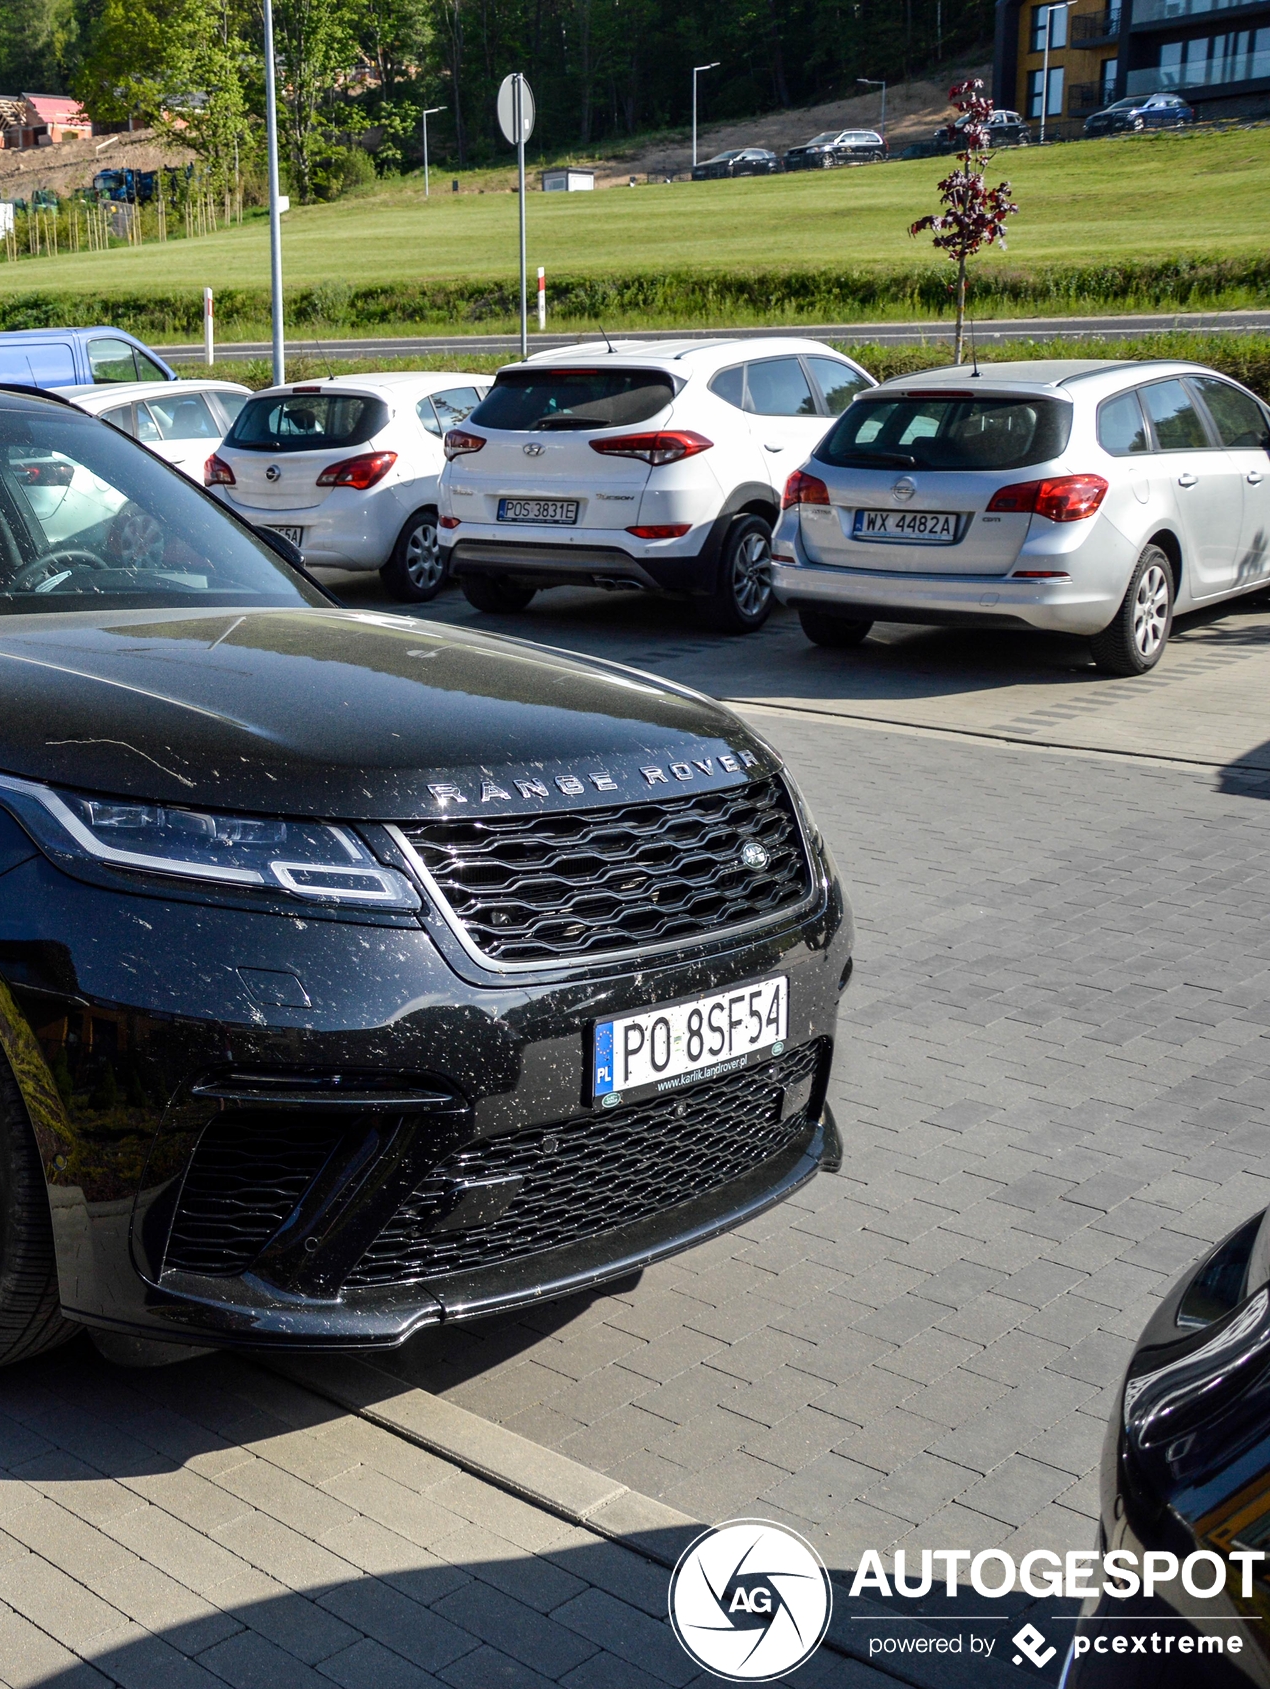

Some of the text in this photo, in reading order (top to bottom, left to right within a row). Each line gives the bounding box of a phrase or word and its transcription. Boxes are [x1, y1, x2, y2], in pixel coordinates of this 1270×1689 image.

[505, 501, 575, 519] POS 3831E
[867, 513, 890, 532] WX
[895, 514, 951, 535] 4482A
[427, 749, 759, 802] RANGE ROVER
[623, 984, 780, 1084] PO 8SF54
[597, 1068, 612, 1084] PL
[657, 1054, 748, 1092] www.karlik.landrover.pl
